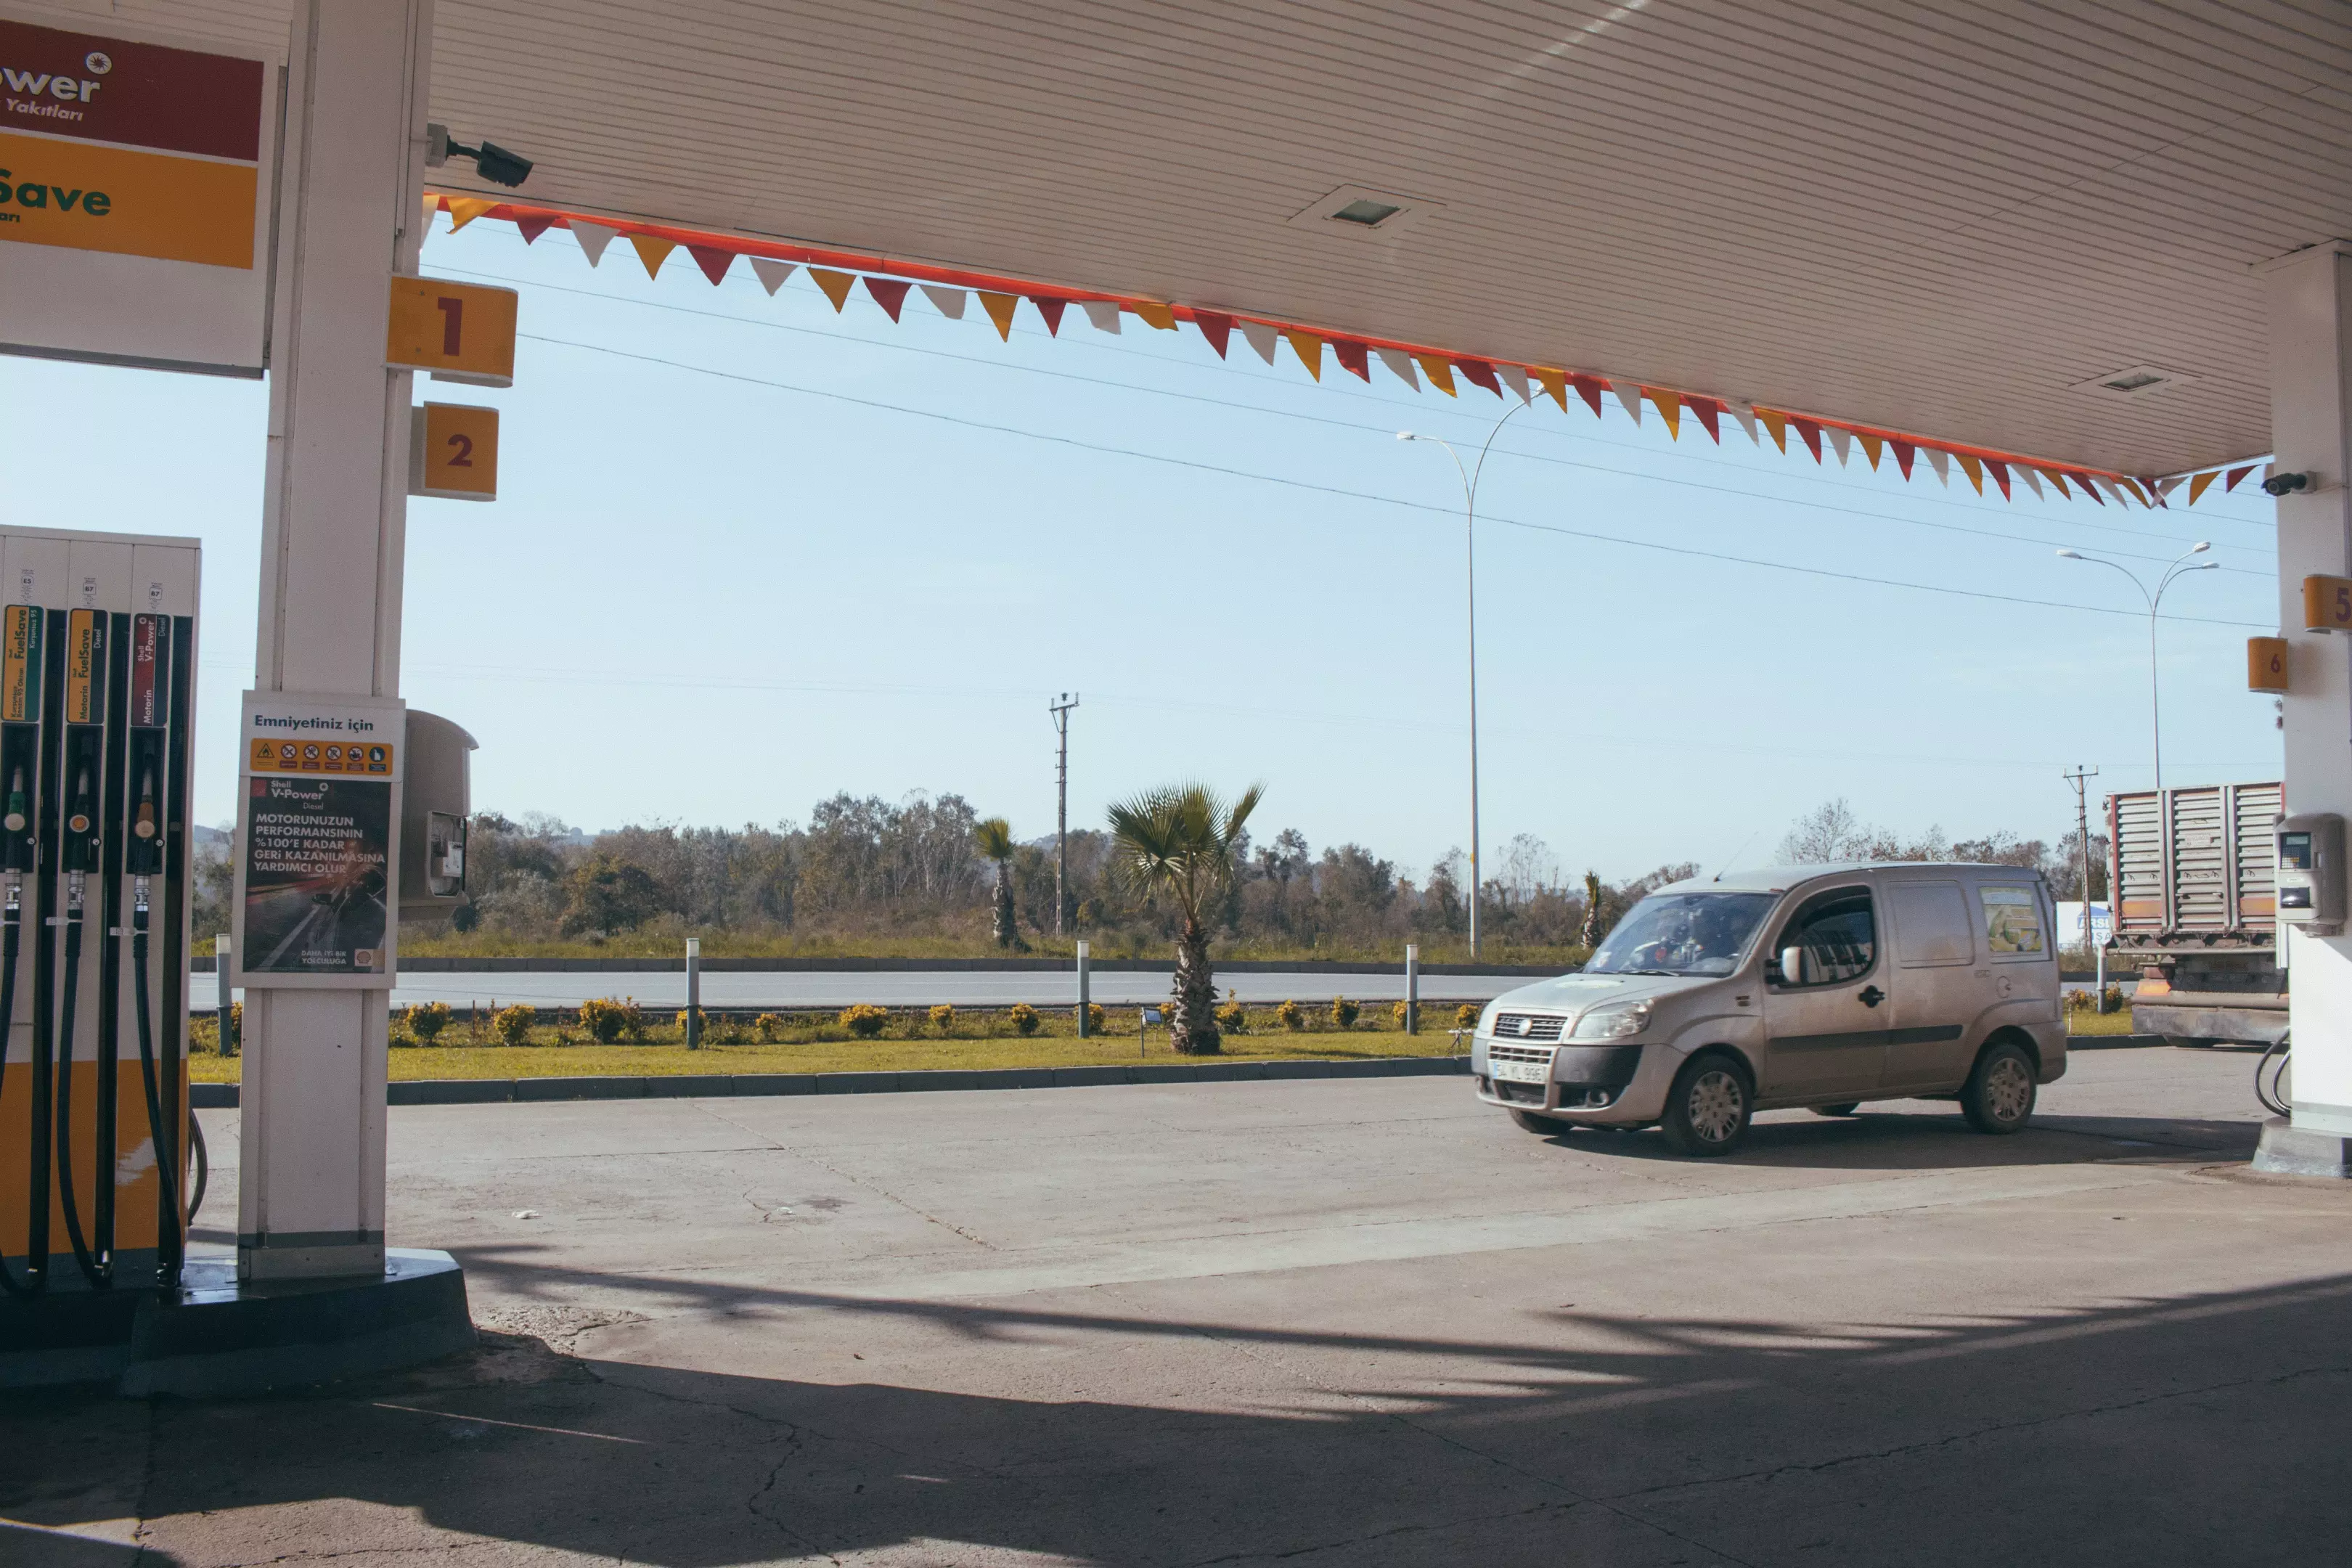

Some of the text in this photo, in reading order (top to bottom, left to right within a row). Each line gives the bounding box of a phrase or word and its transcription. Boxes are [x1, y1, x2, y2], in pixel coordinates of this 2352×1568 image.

[0, 67, 101, 103] wer
[6, 98, 84, 121] Yakıtları
[437, 296, 463, 356] 1
[446, 433, 473, 467] 2
[2335, 587, 2351, 622] 5
[14, 609, 27, 659] FuelSave
[158, 617, 167, 637] Diesel
[2270, 653, 2281, 674] 6
[78, 629, 91, 720] Motorin FuelSave
[143, 689, 152, 724] Motorin
[254, 714, 374, 734] Emniyetiniz için
[271, 788, 324, 801] V-Power
[303, 801, 324, 811] Diesel
[256, 813, 354, 827] MOTORUNUZUN
[256, 826, 364, 839] PERFORMANSININ
[303, 839, 346, 850] KADAR
[285, 850, 386, 863] KAZANILMASINA
[254, 861, 347, 874] YARDIMCI OLUR
